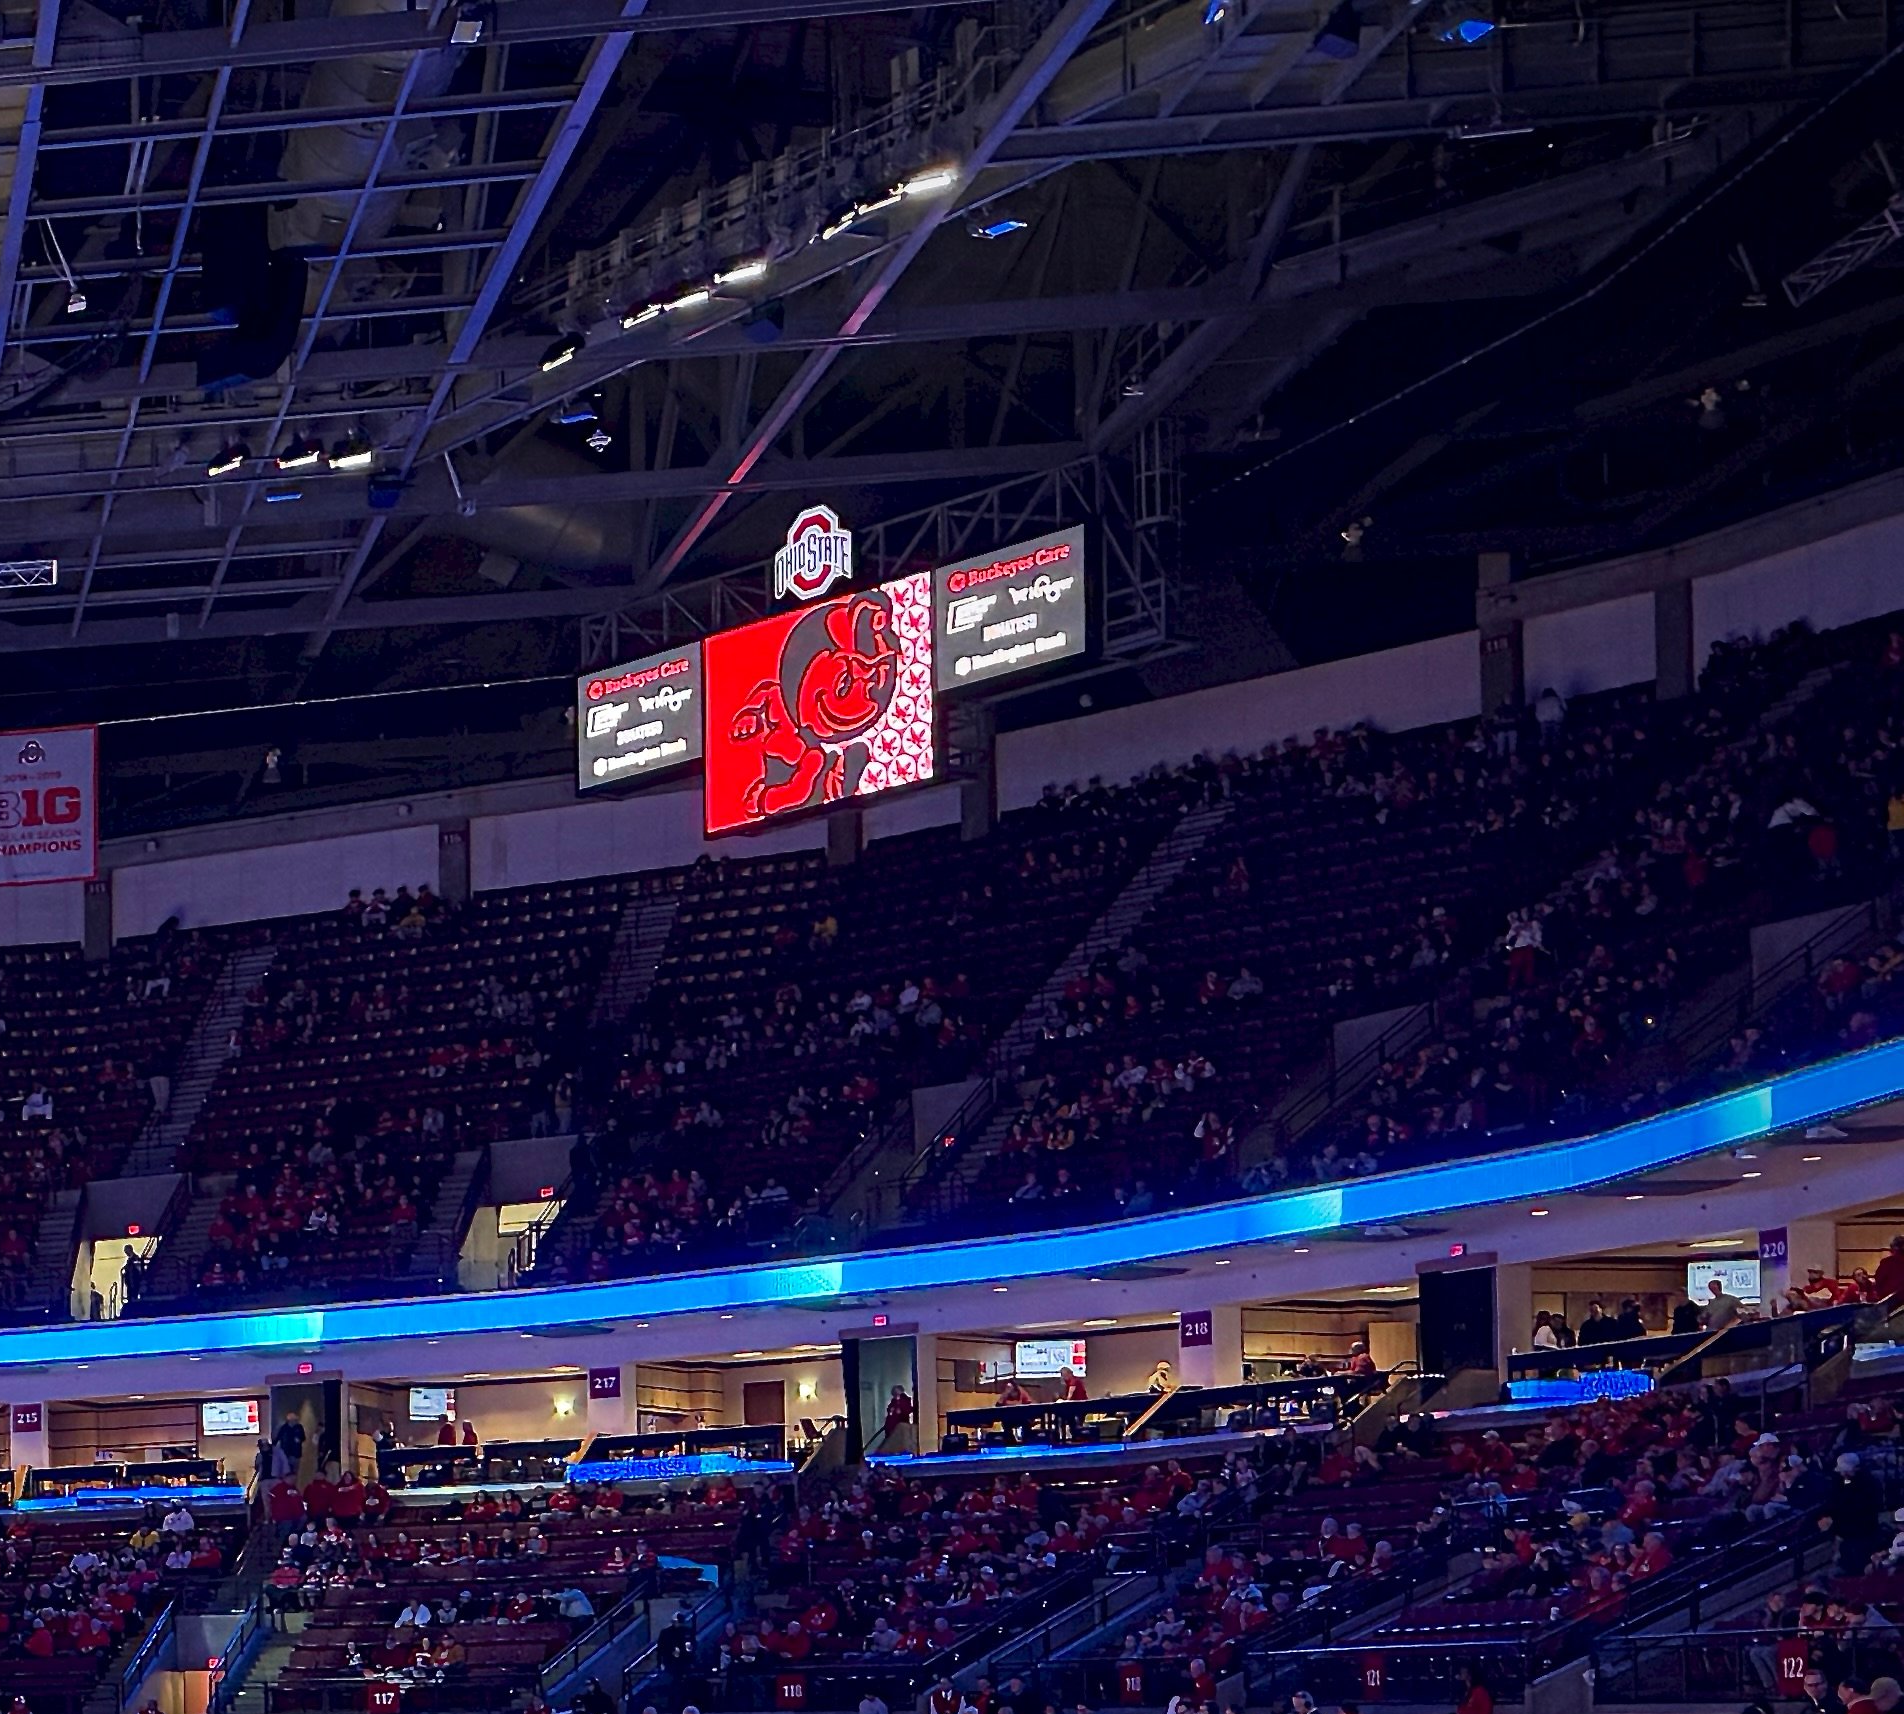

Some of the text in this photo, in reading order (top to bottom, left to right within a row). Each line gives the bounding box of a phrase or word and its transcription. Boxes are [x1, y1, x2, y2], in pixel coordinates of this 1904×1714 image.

[1034, 543, 1071, 566] Care
[659, 657, 690, 680] Care
[1763, 1241, 1785, 1258] 220
[1185, 1322, 1208, 1336] 218
[594, 1376, 616, 1389] 217
[16, 1412, 38, 1424] 215
[1784, 1656, 1804, 1678] 122
[373, 1693, 395, 1704] 117
